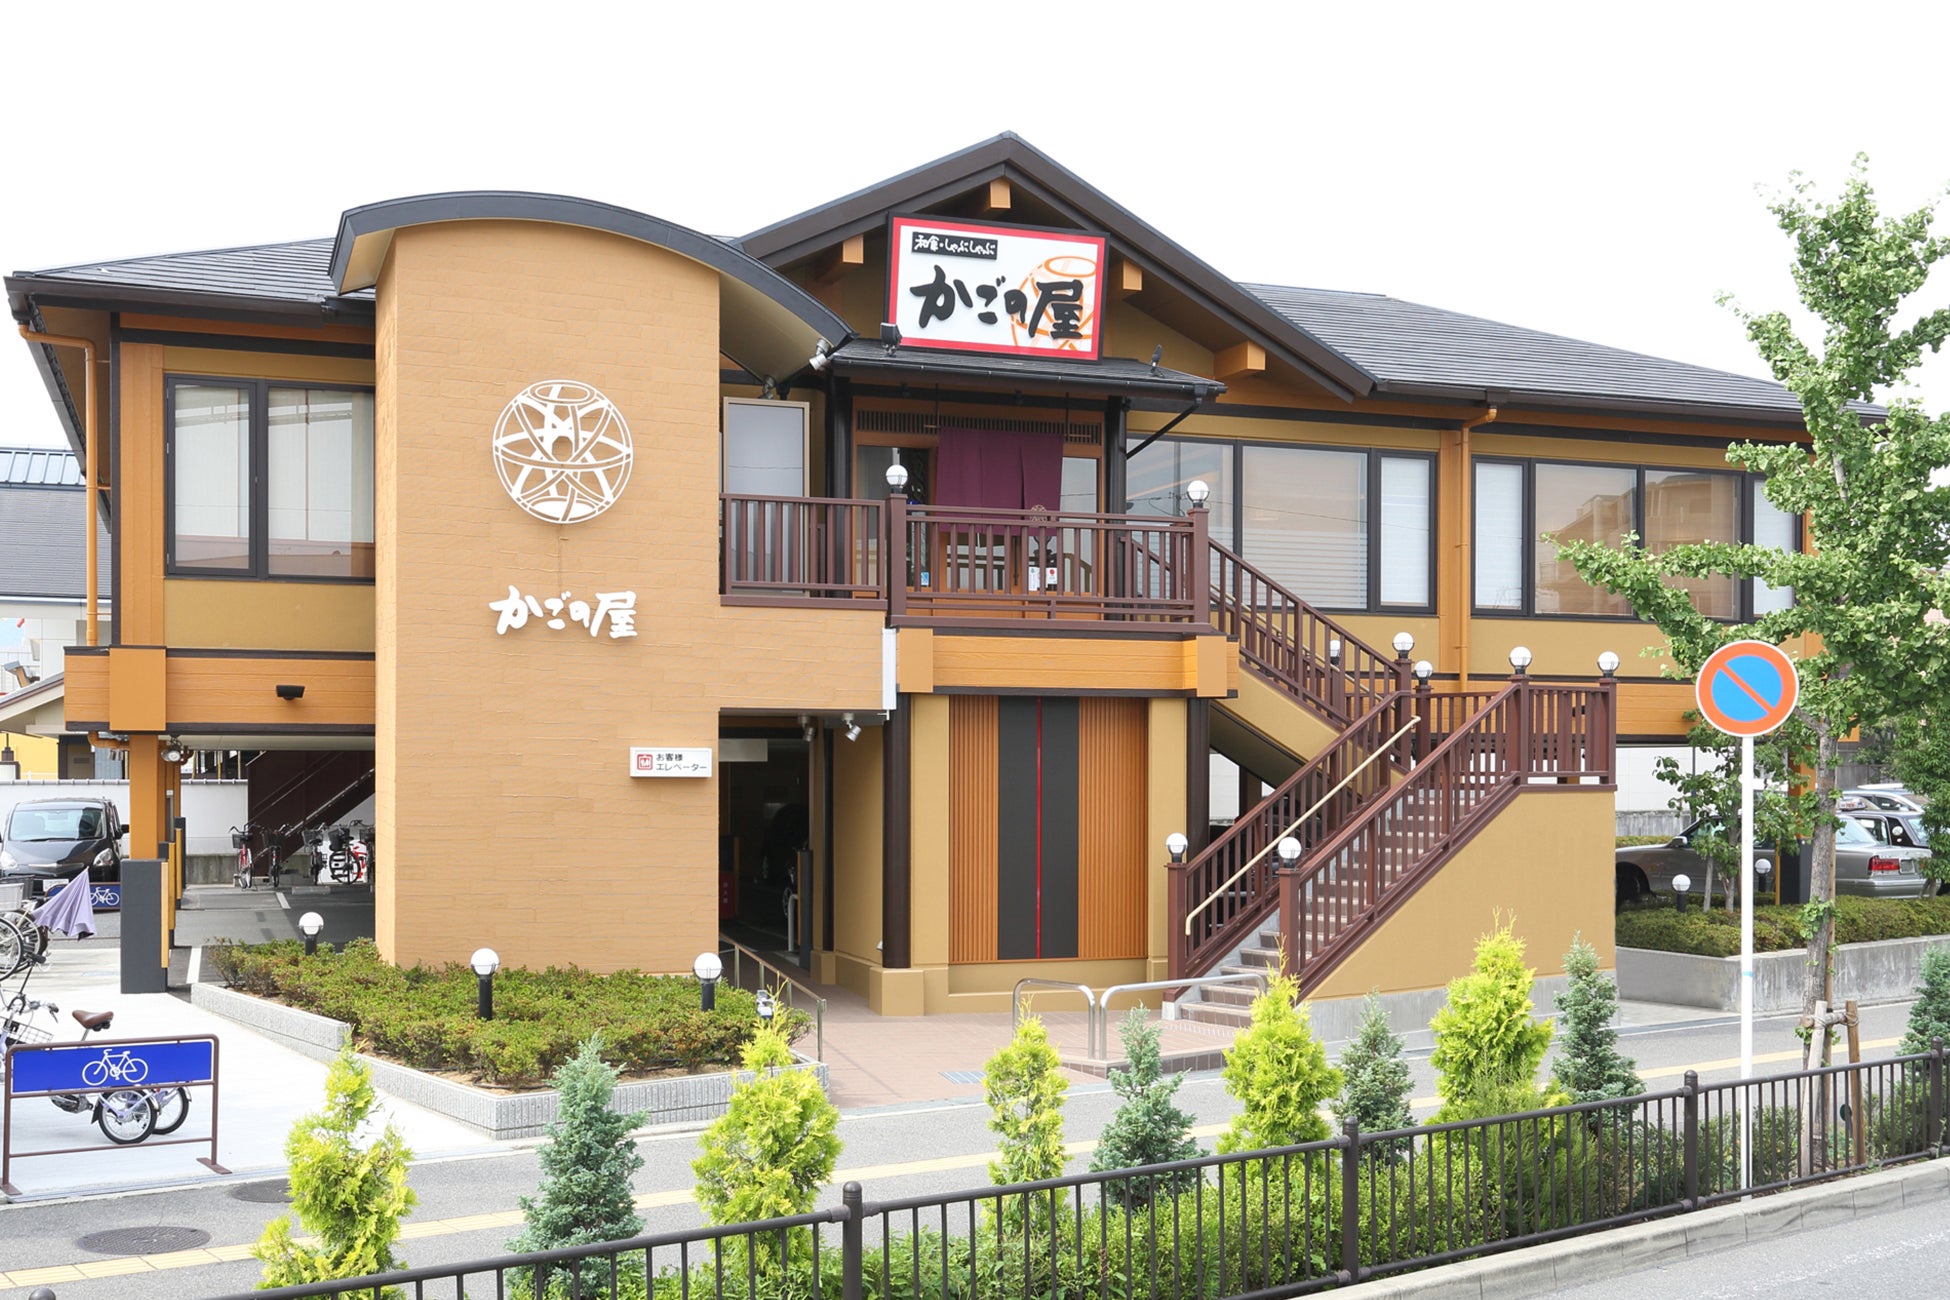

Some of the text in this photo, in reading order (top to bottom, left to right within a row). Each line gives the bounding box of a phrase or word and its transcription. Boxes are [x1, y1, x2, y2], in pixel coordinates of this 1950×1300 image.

[910, 264, 1084, 340] かごの屋
[489, 585, 638, 639] かごの屋
[656, 753, 683, 761] お客様
